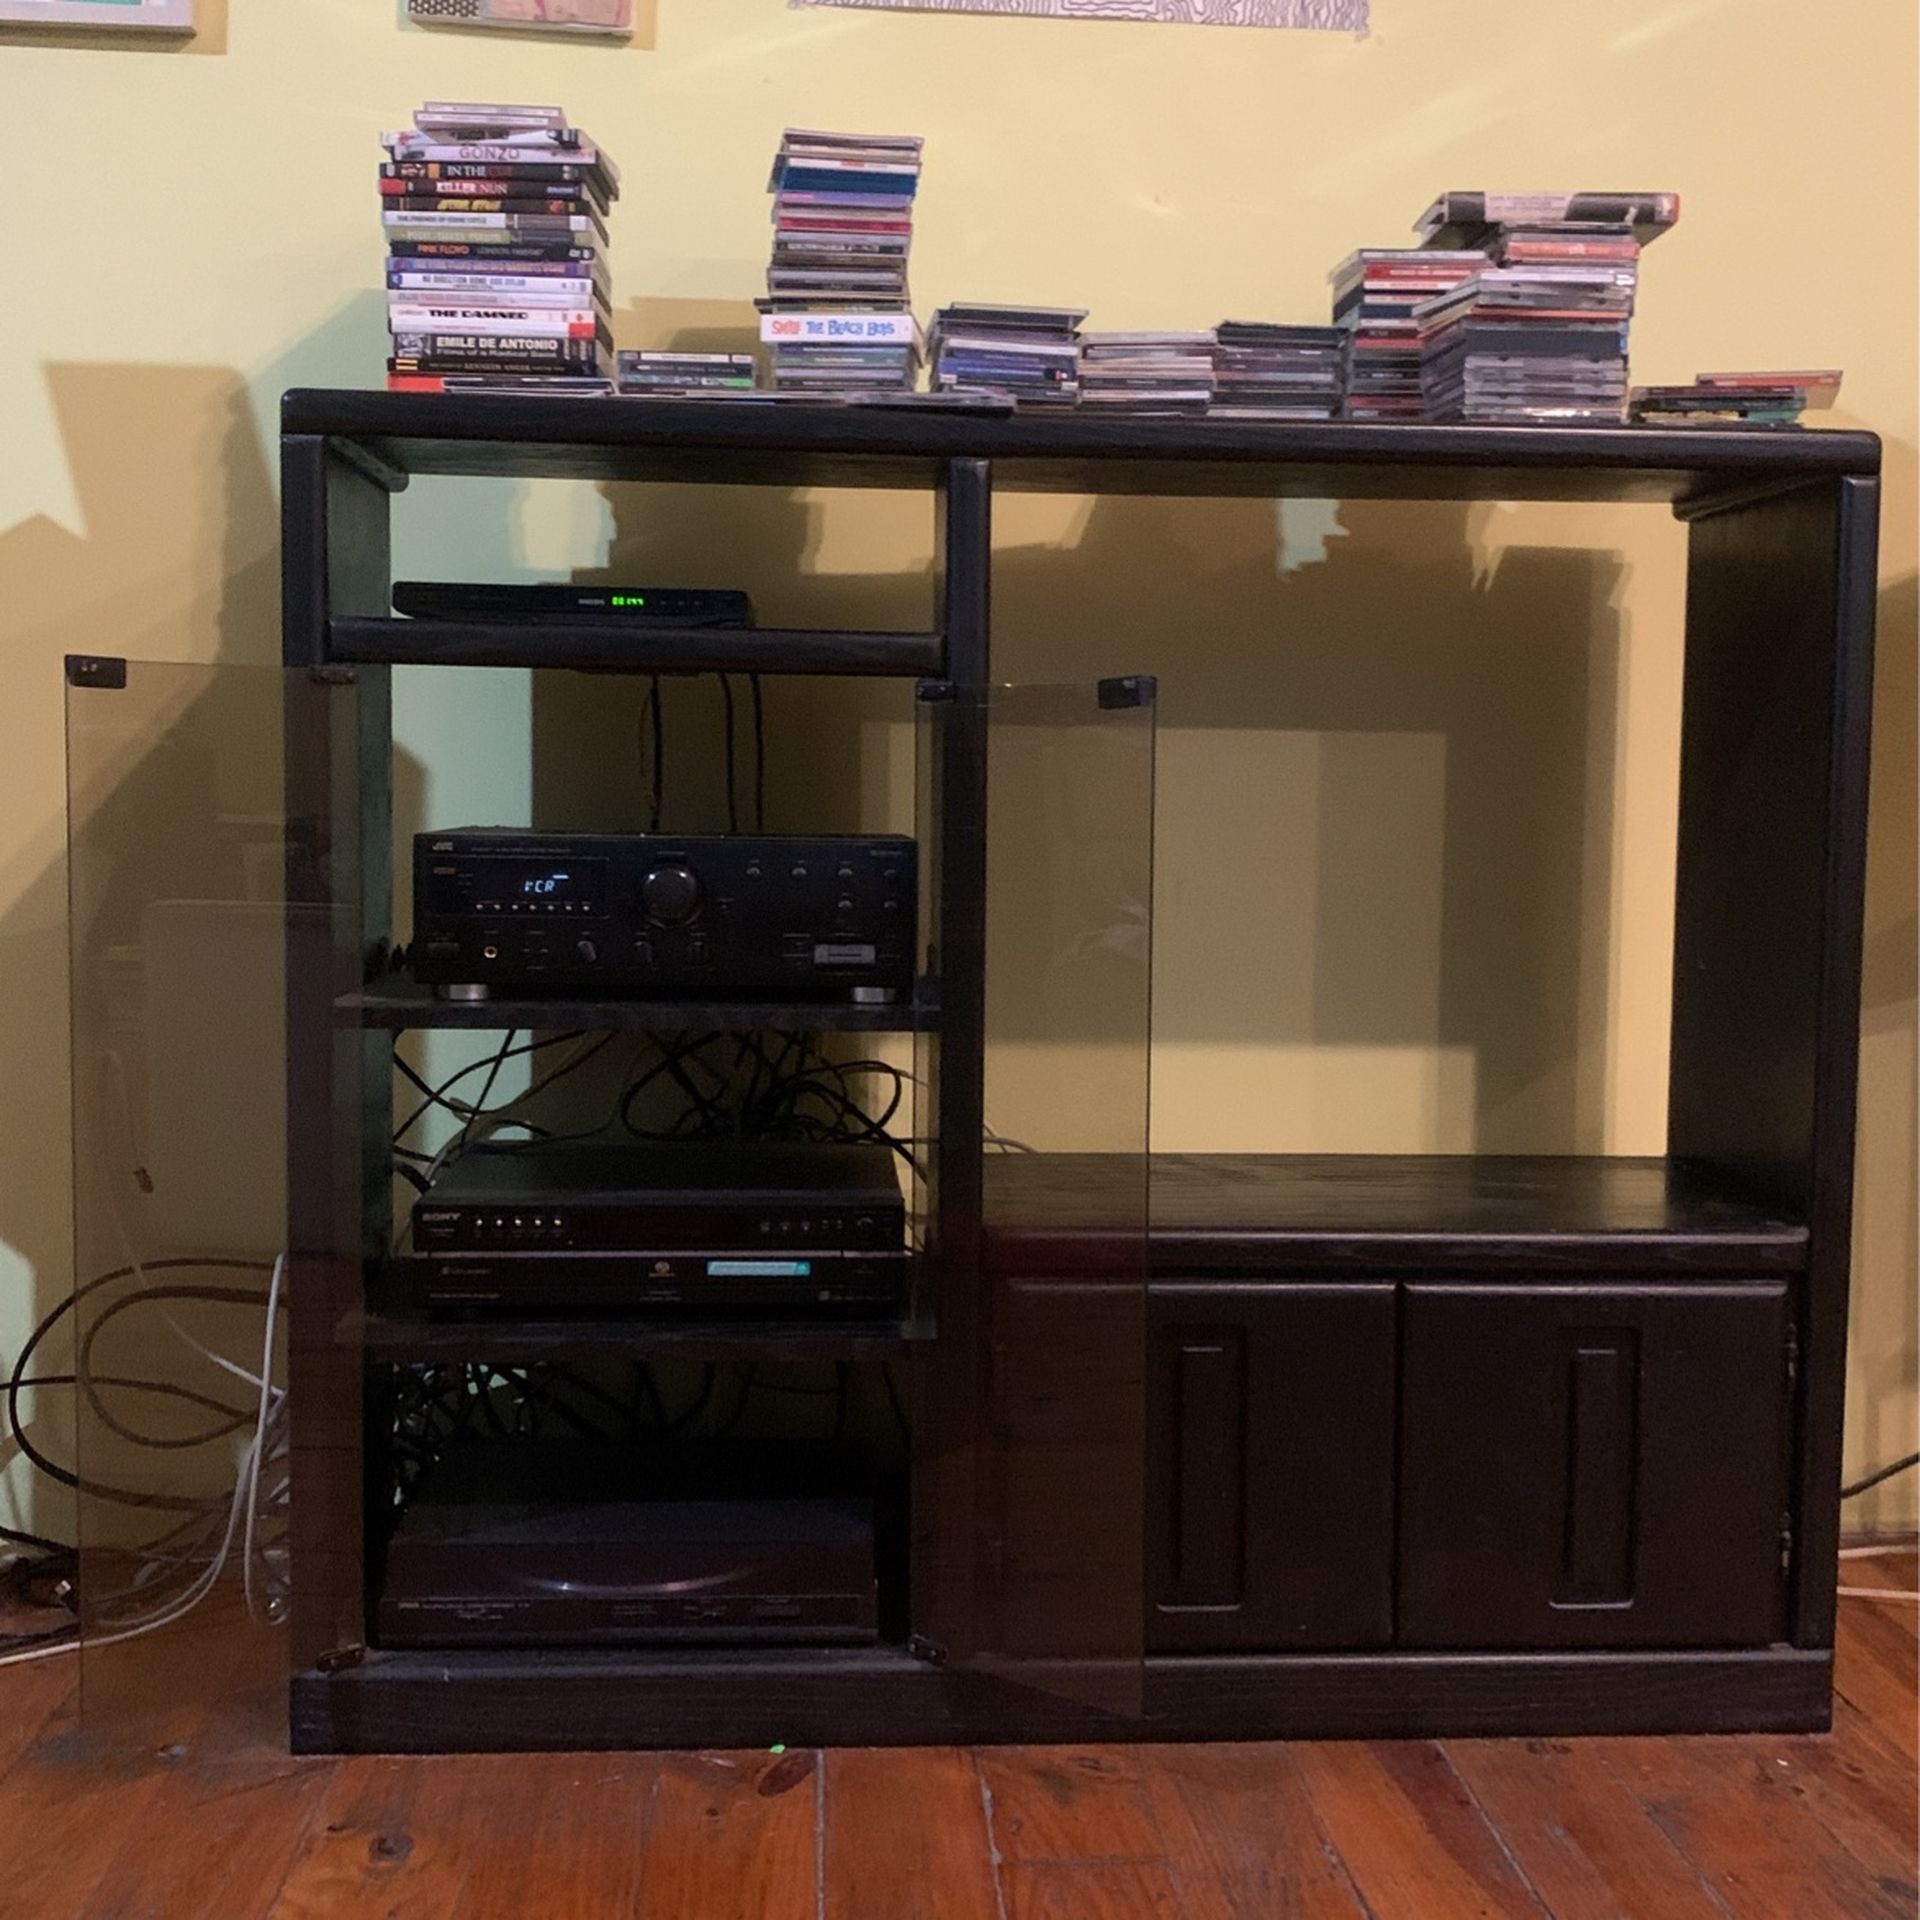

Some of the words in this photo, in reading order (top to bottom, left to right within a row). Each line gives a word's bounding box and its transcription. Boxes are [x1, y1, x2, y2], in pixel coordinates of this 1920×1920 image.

[459, 146, 519, 159] GONZO
[447, 164, 462, 175] IN
[464, 165, 486, 176] THE
[436, 181, 477, 192] KILLER
[439, 244, 470, 255] FLOYD
[428, 309, 458, 318] THE
[461, 310, 529, 319] DAMNED
[805, 320, 825, 334] THE
[436, 336, 475, 348] EMILE
[478, 337, 496, 349] DE
[498, 338, 558, 350] ANTONIO
[422, 1212, 460, 1221] SONY
